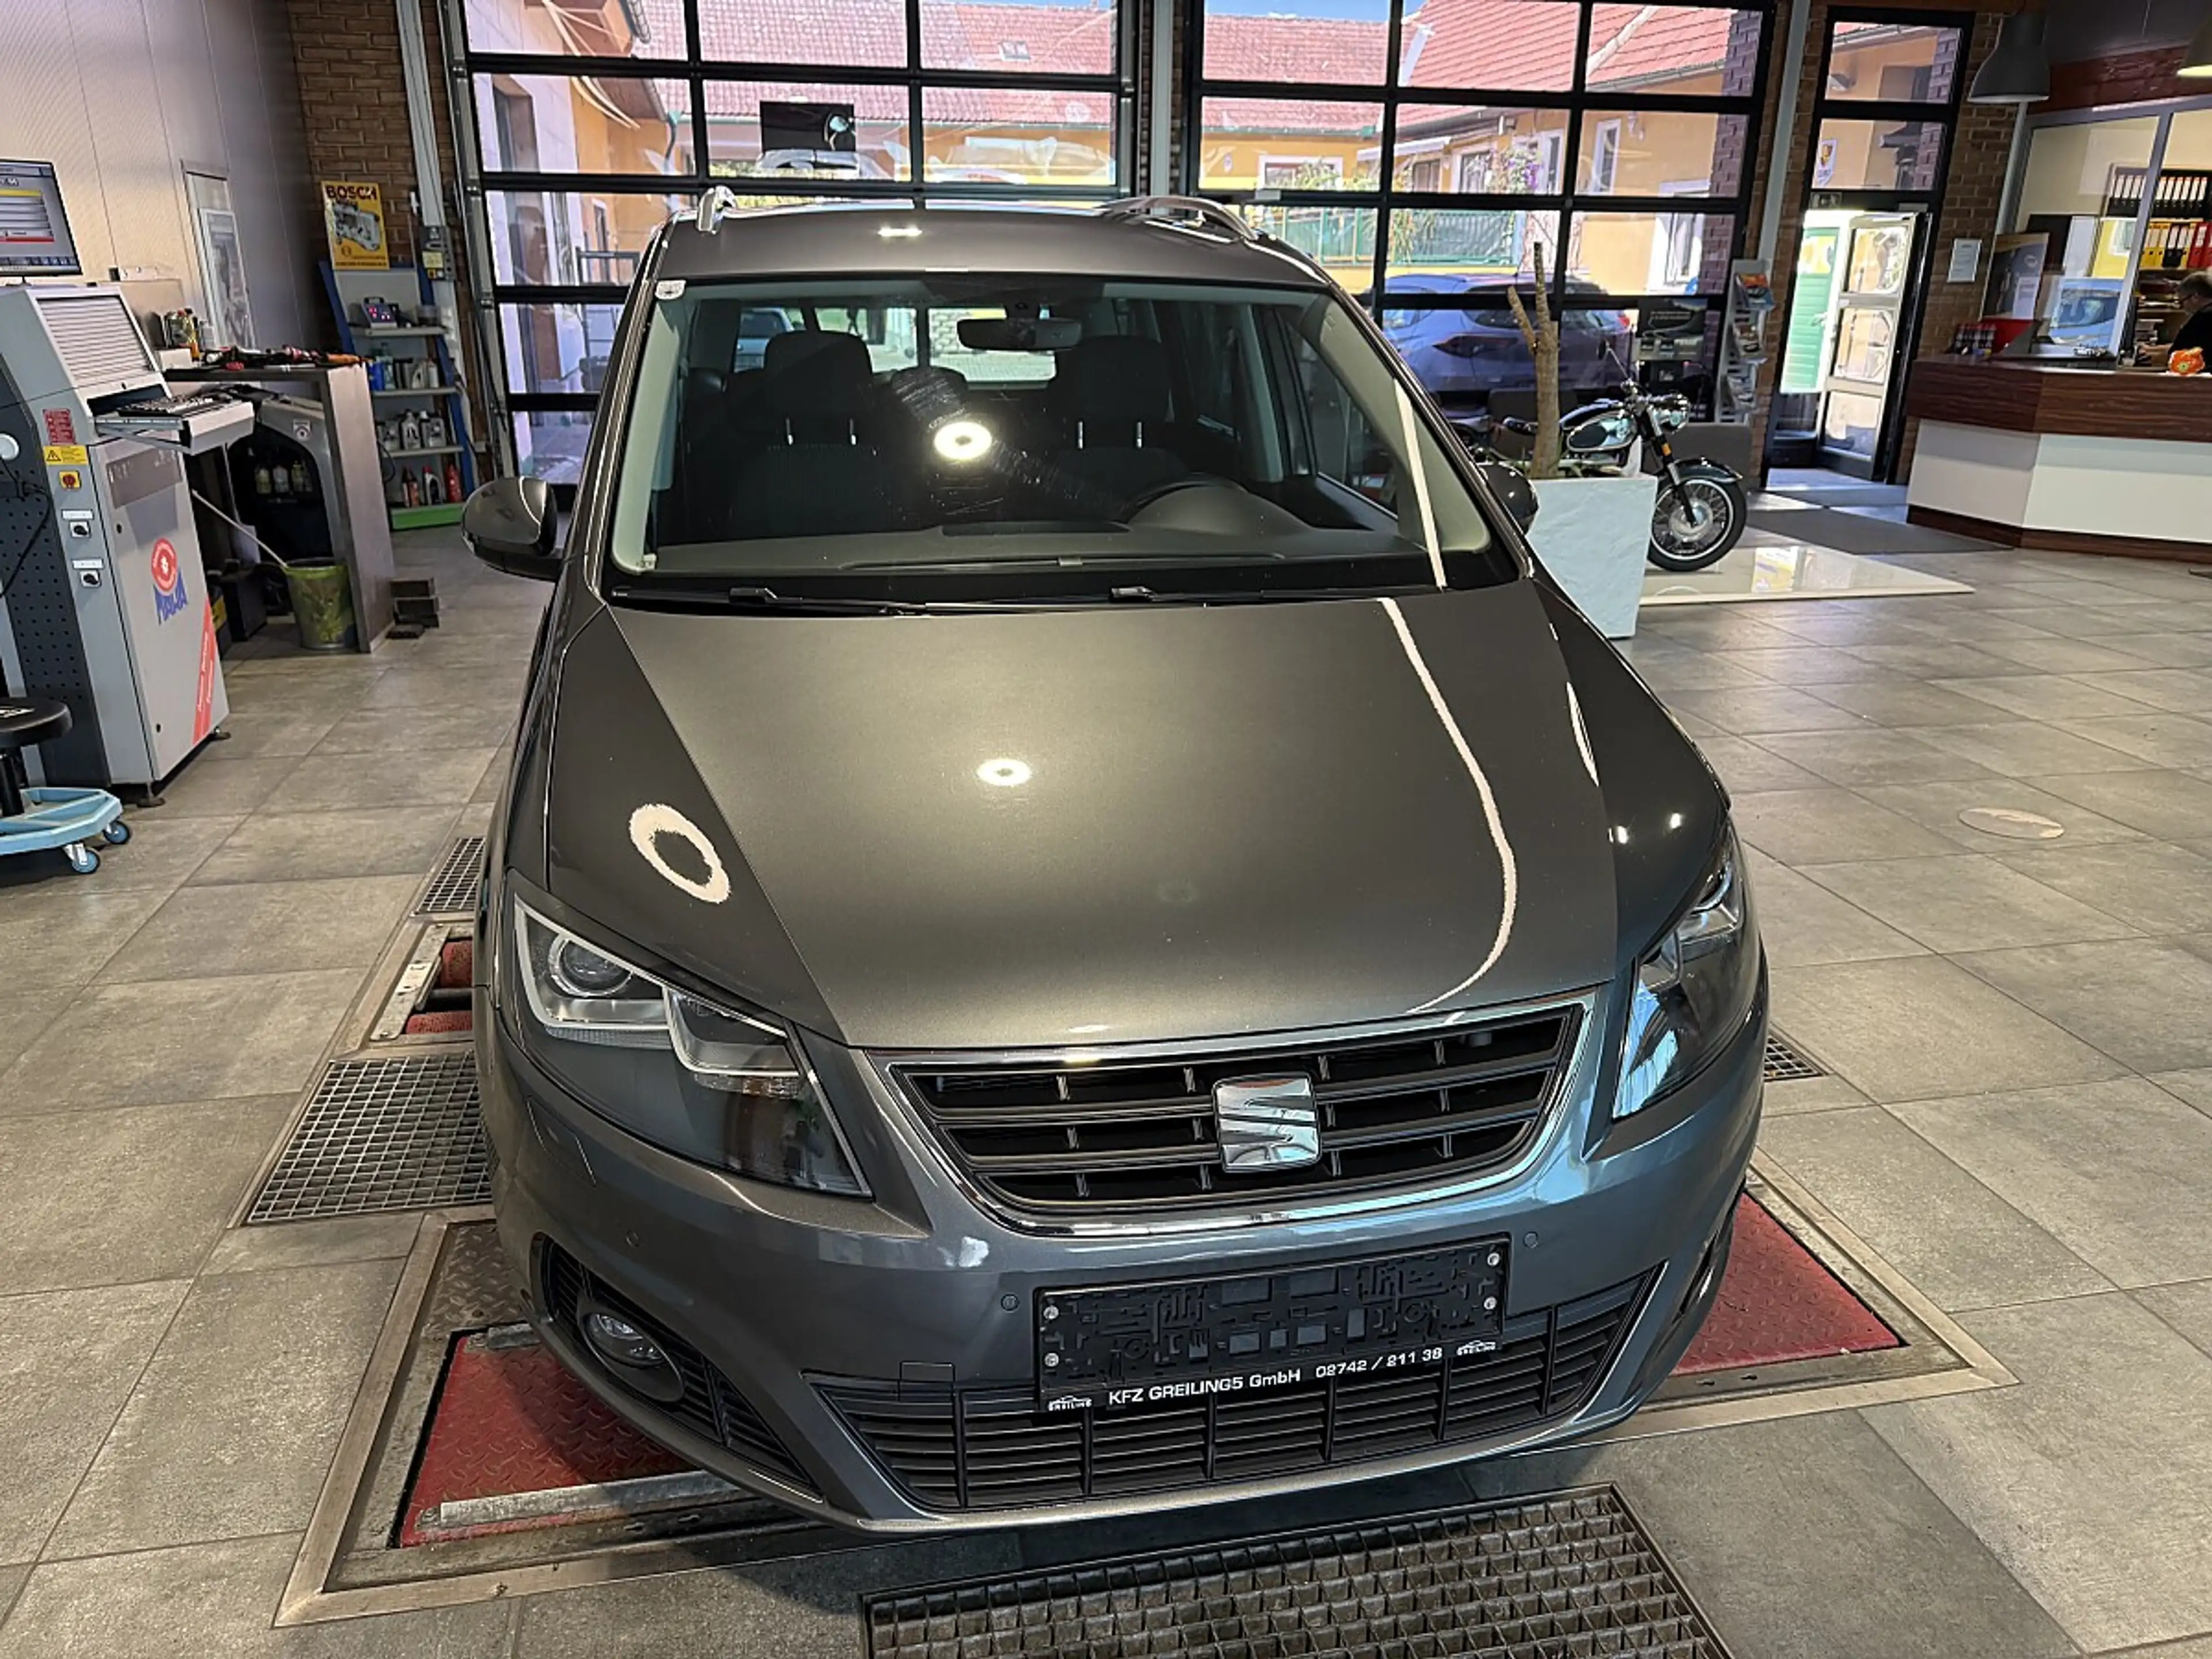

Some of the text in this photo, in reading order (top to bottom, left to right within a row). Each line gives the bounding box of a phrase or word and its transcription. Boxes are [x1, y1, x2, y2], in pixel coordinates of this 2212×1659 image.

[326, 184, 377, 200] BOSCH
[1109, 1388, 1144, 1406] KFZ
[1249, 1368, 1301, 1388] GmbH
